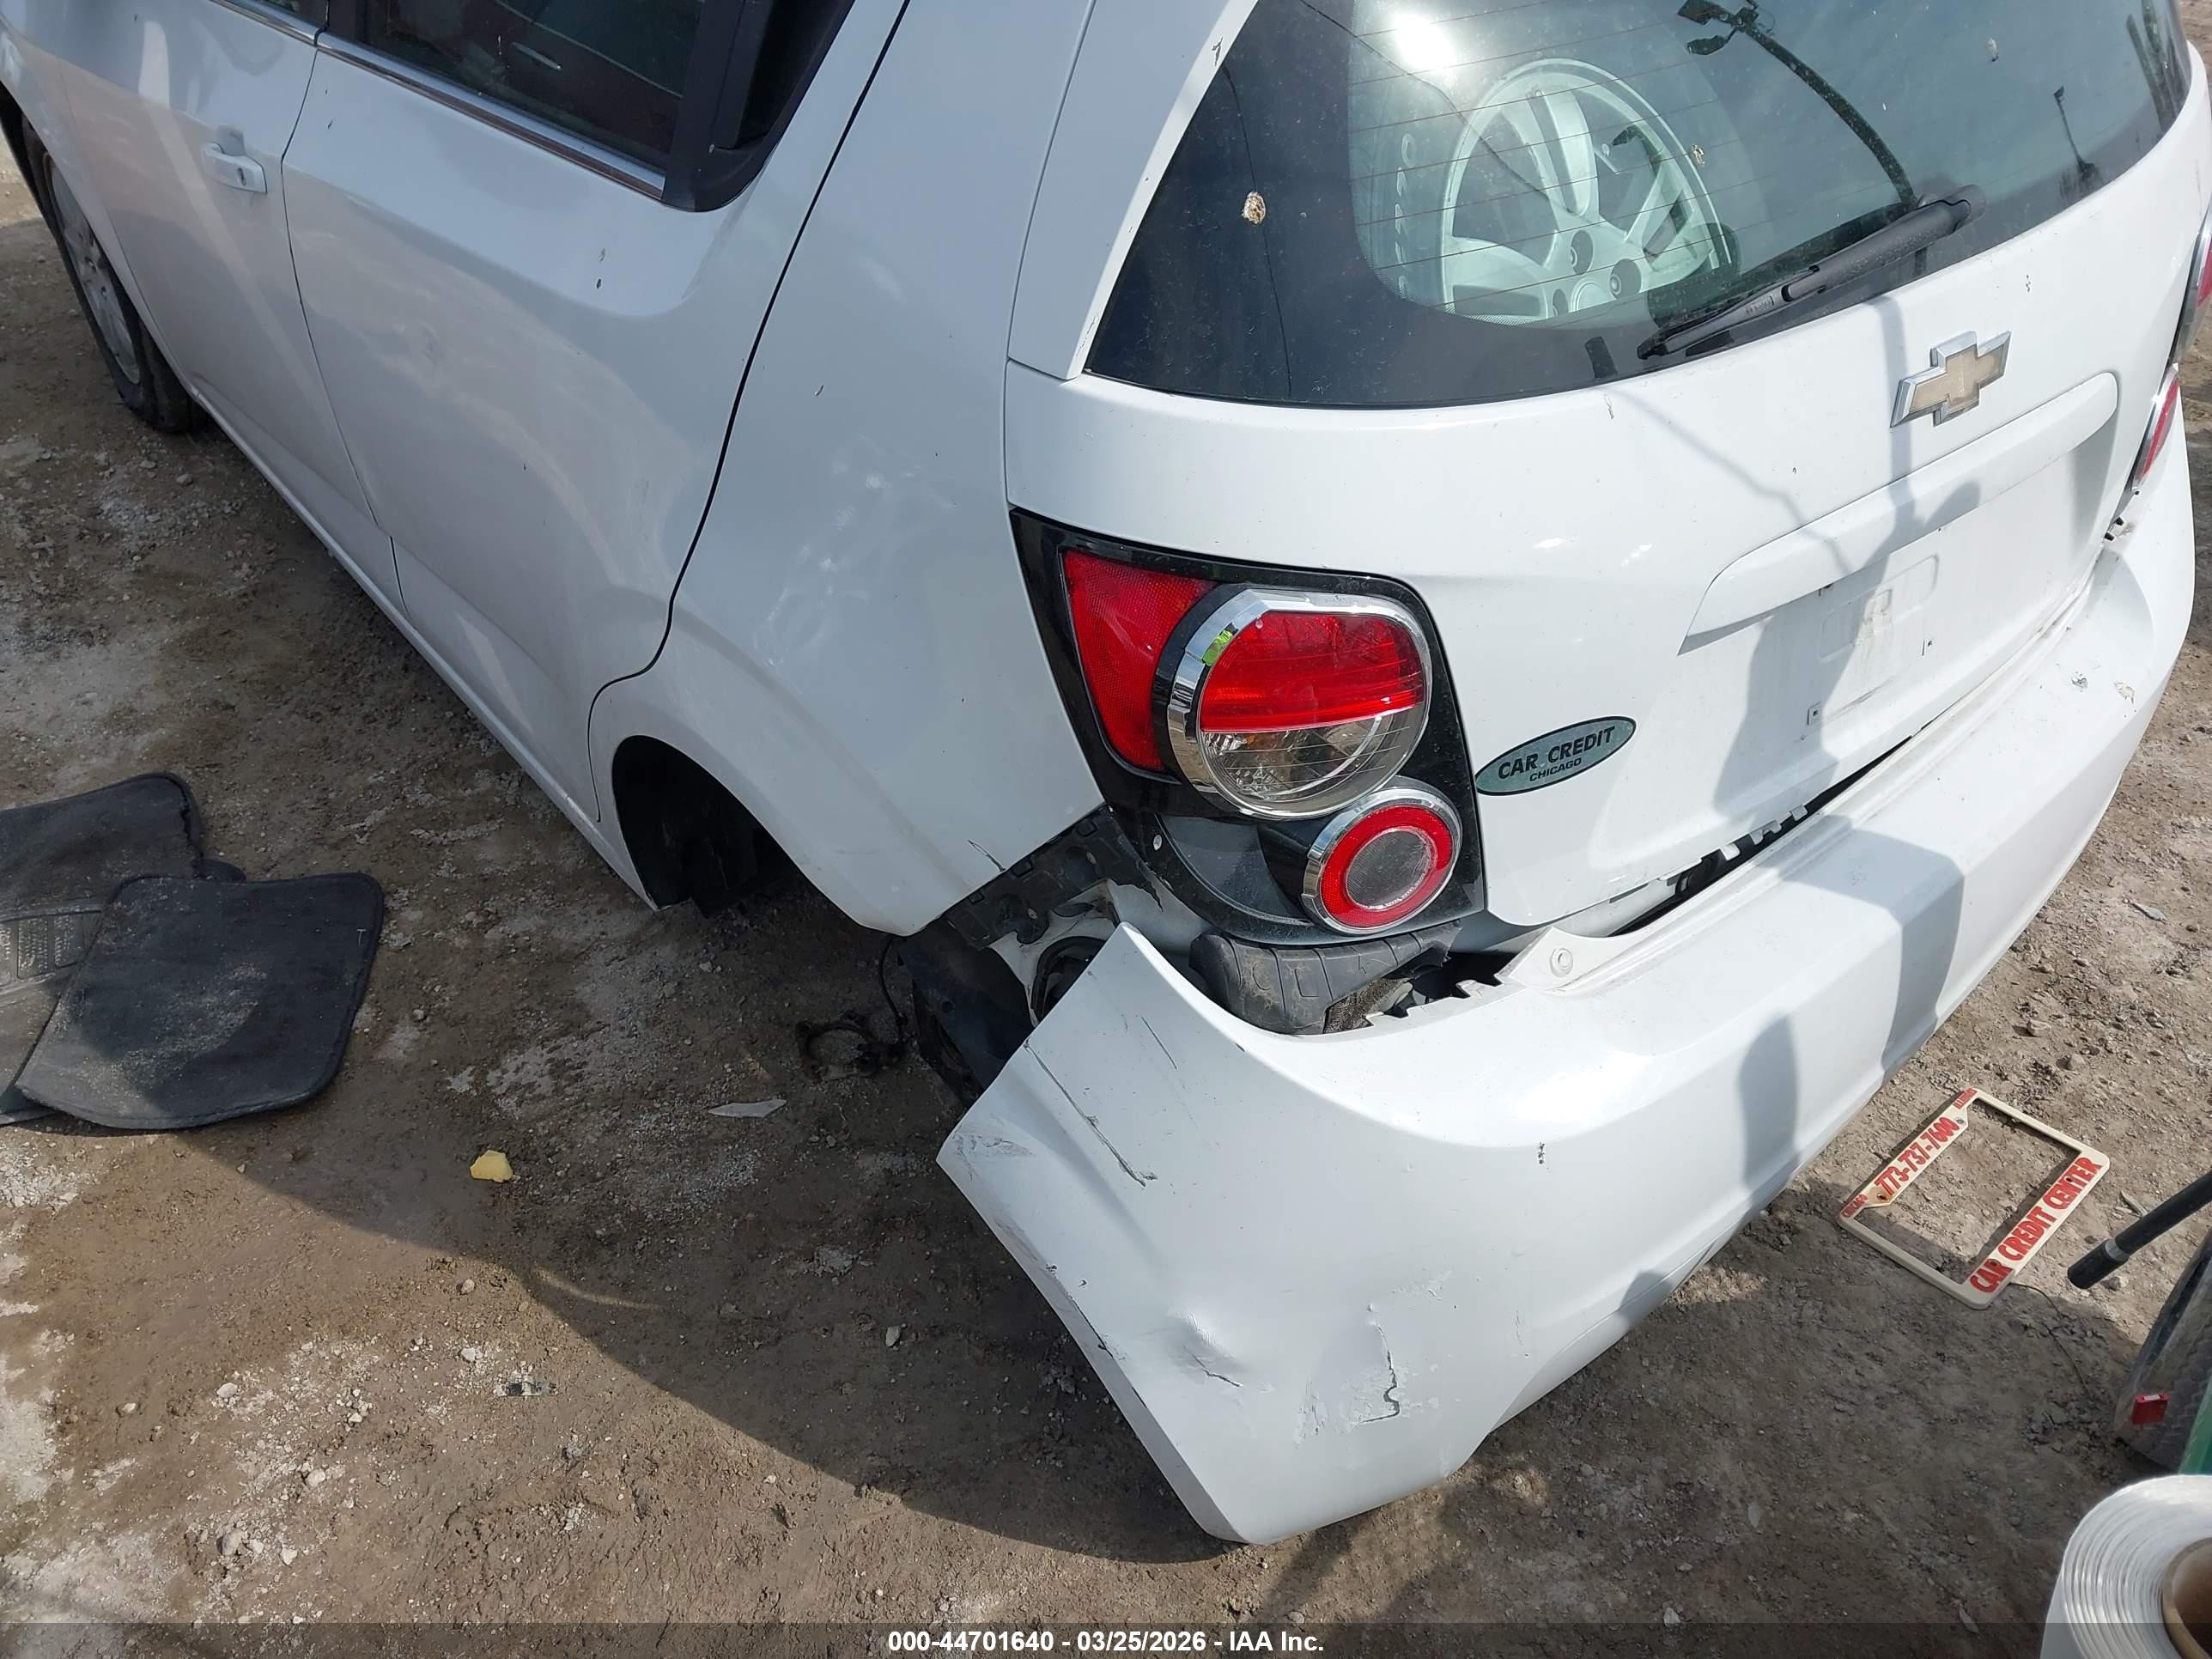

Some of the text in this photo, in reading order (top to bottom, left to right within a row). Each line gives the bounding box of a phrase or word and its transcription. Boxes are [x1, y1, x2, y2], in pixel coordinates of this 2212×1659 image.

[1498, 726, 1616, 780] CAR CREDIT
[1528, 757, 1583, 782] CHICAGO
[1875, 1116, 1960, 1197] 773-737-7600
[1970, 1157, 2103, 1292] CAR CREDIT CENTER
